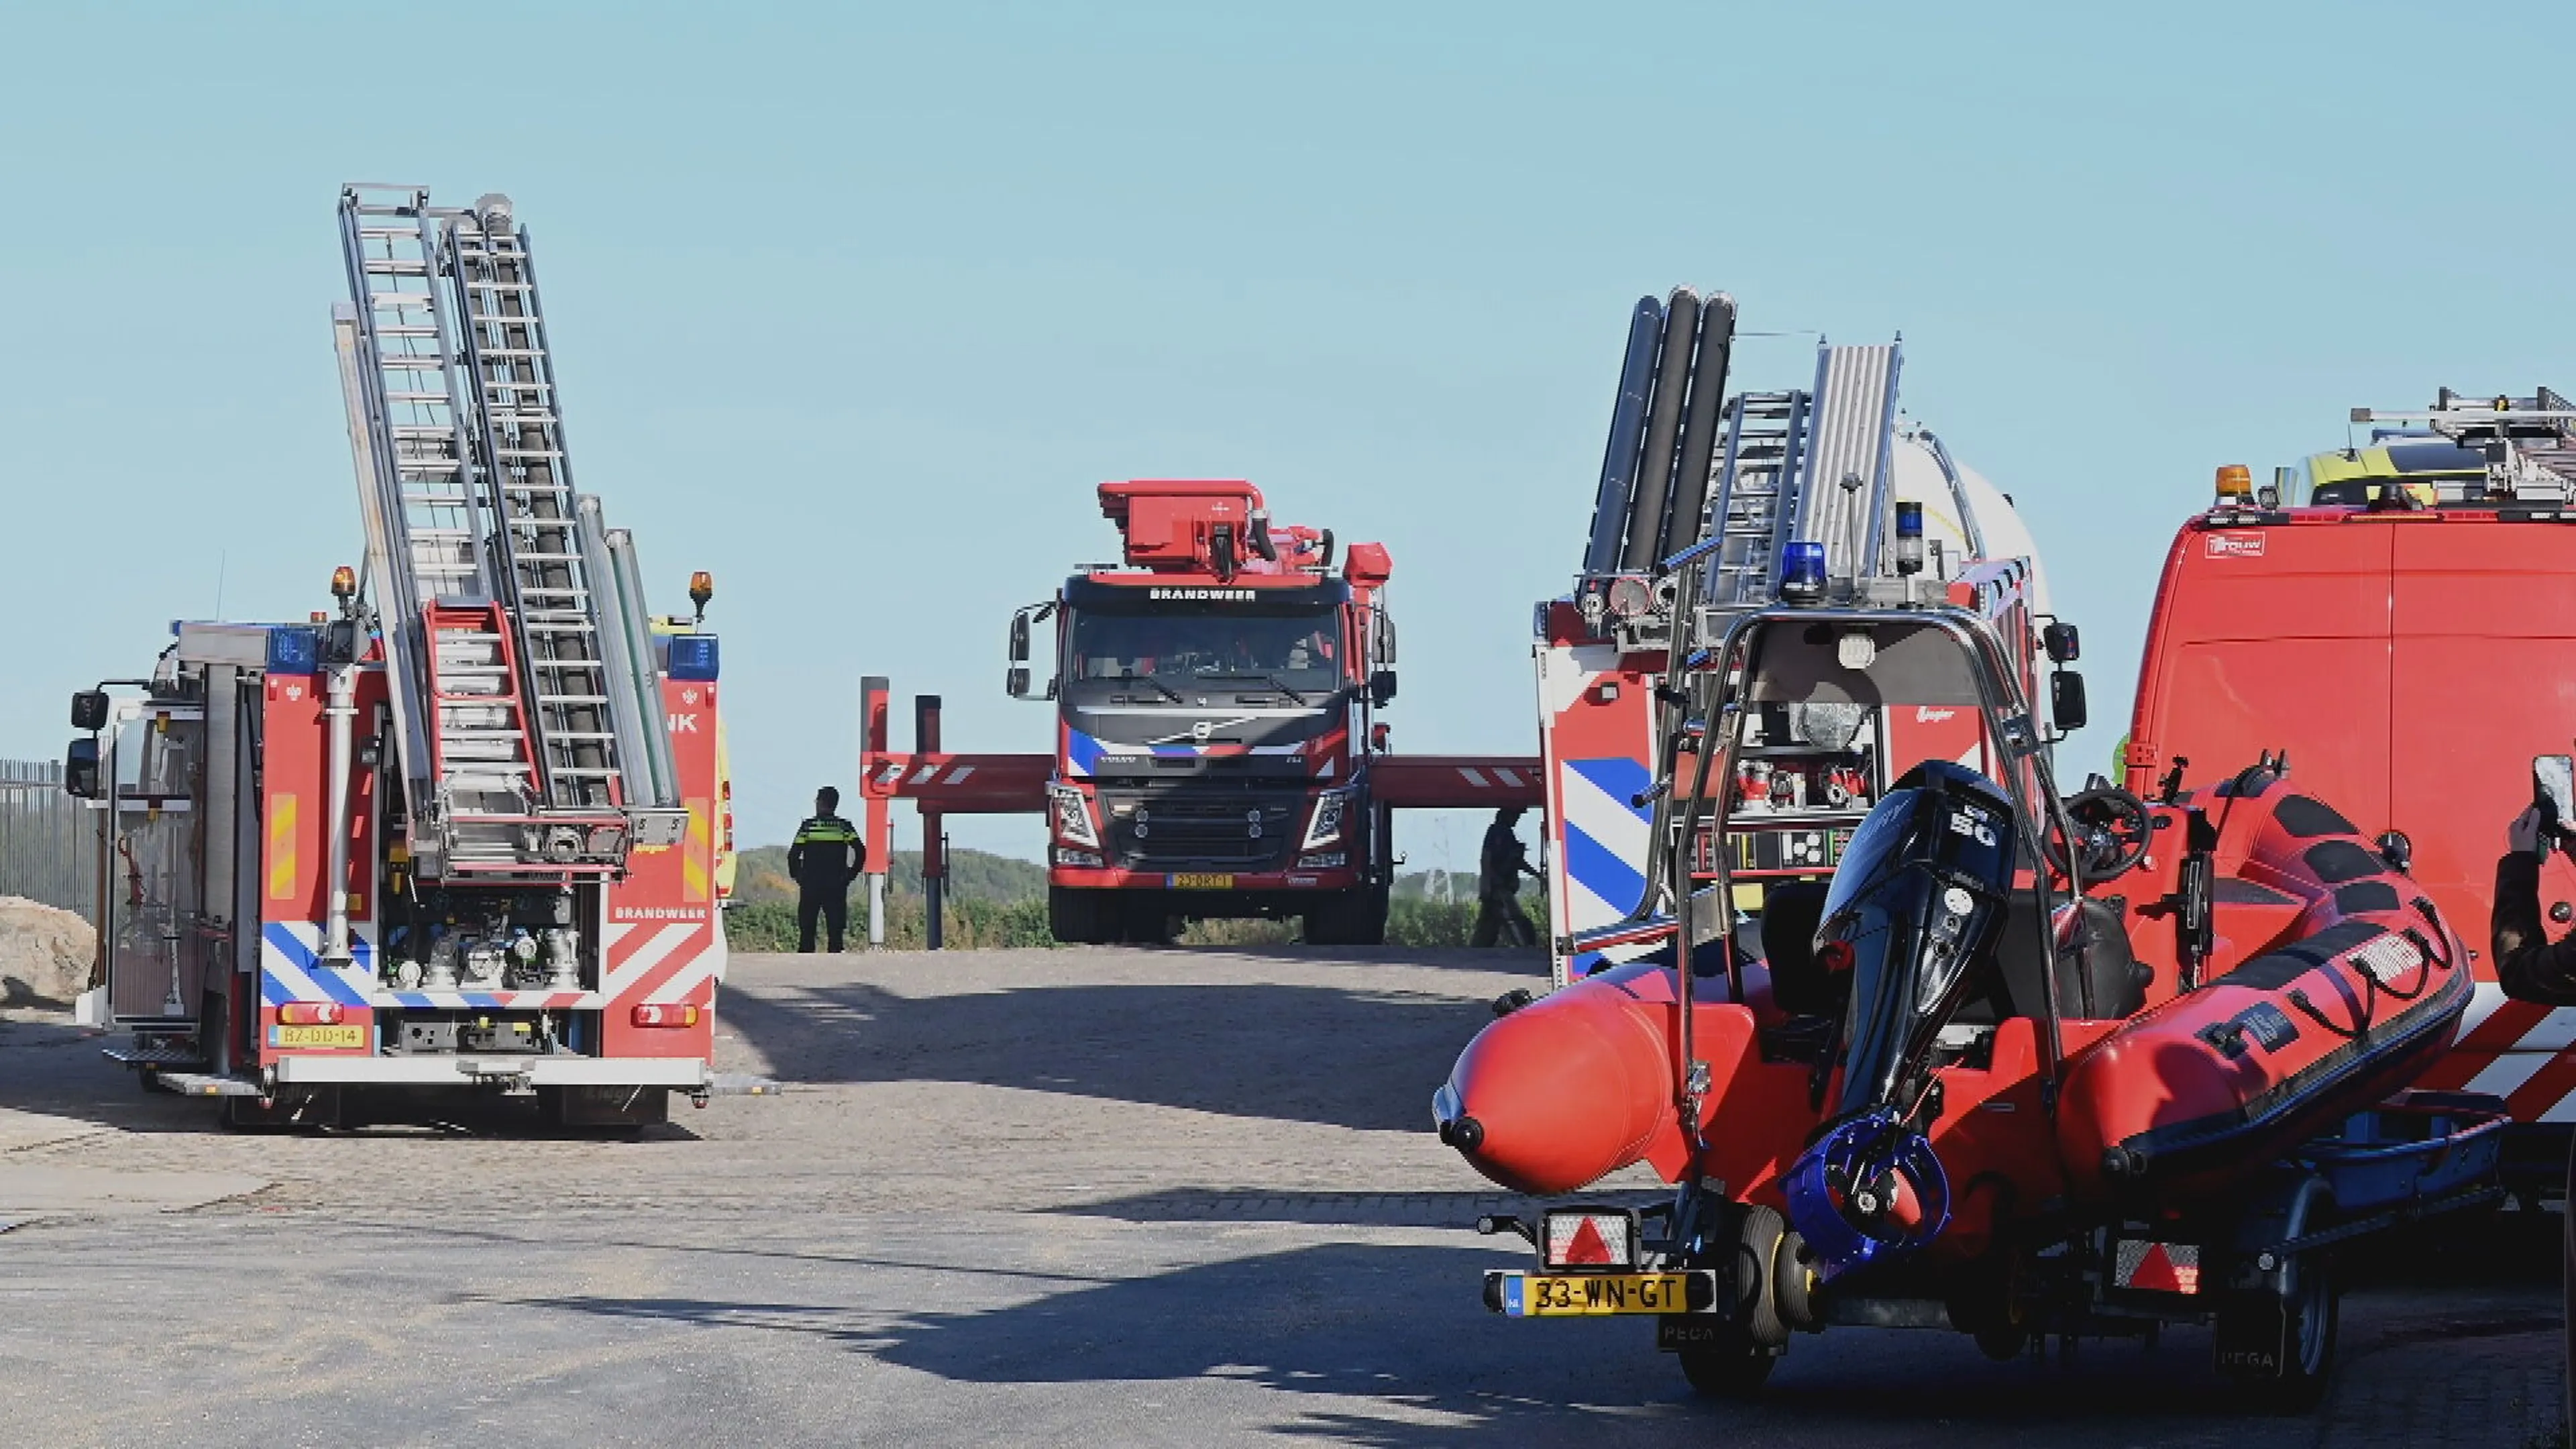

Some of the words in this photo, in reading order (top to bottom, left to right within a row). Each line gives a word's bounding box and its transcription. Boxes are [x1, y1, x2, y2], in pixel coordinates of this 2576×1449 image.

[1149, 588, 1256, 602] BRANDWEER
[615, 907, 706, 918] BRANDWEER
[1535, 1280, 1676, 1308] 33-WN-GT
